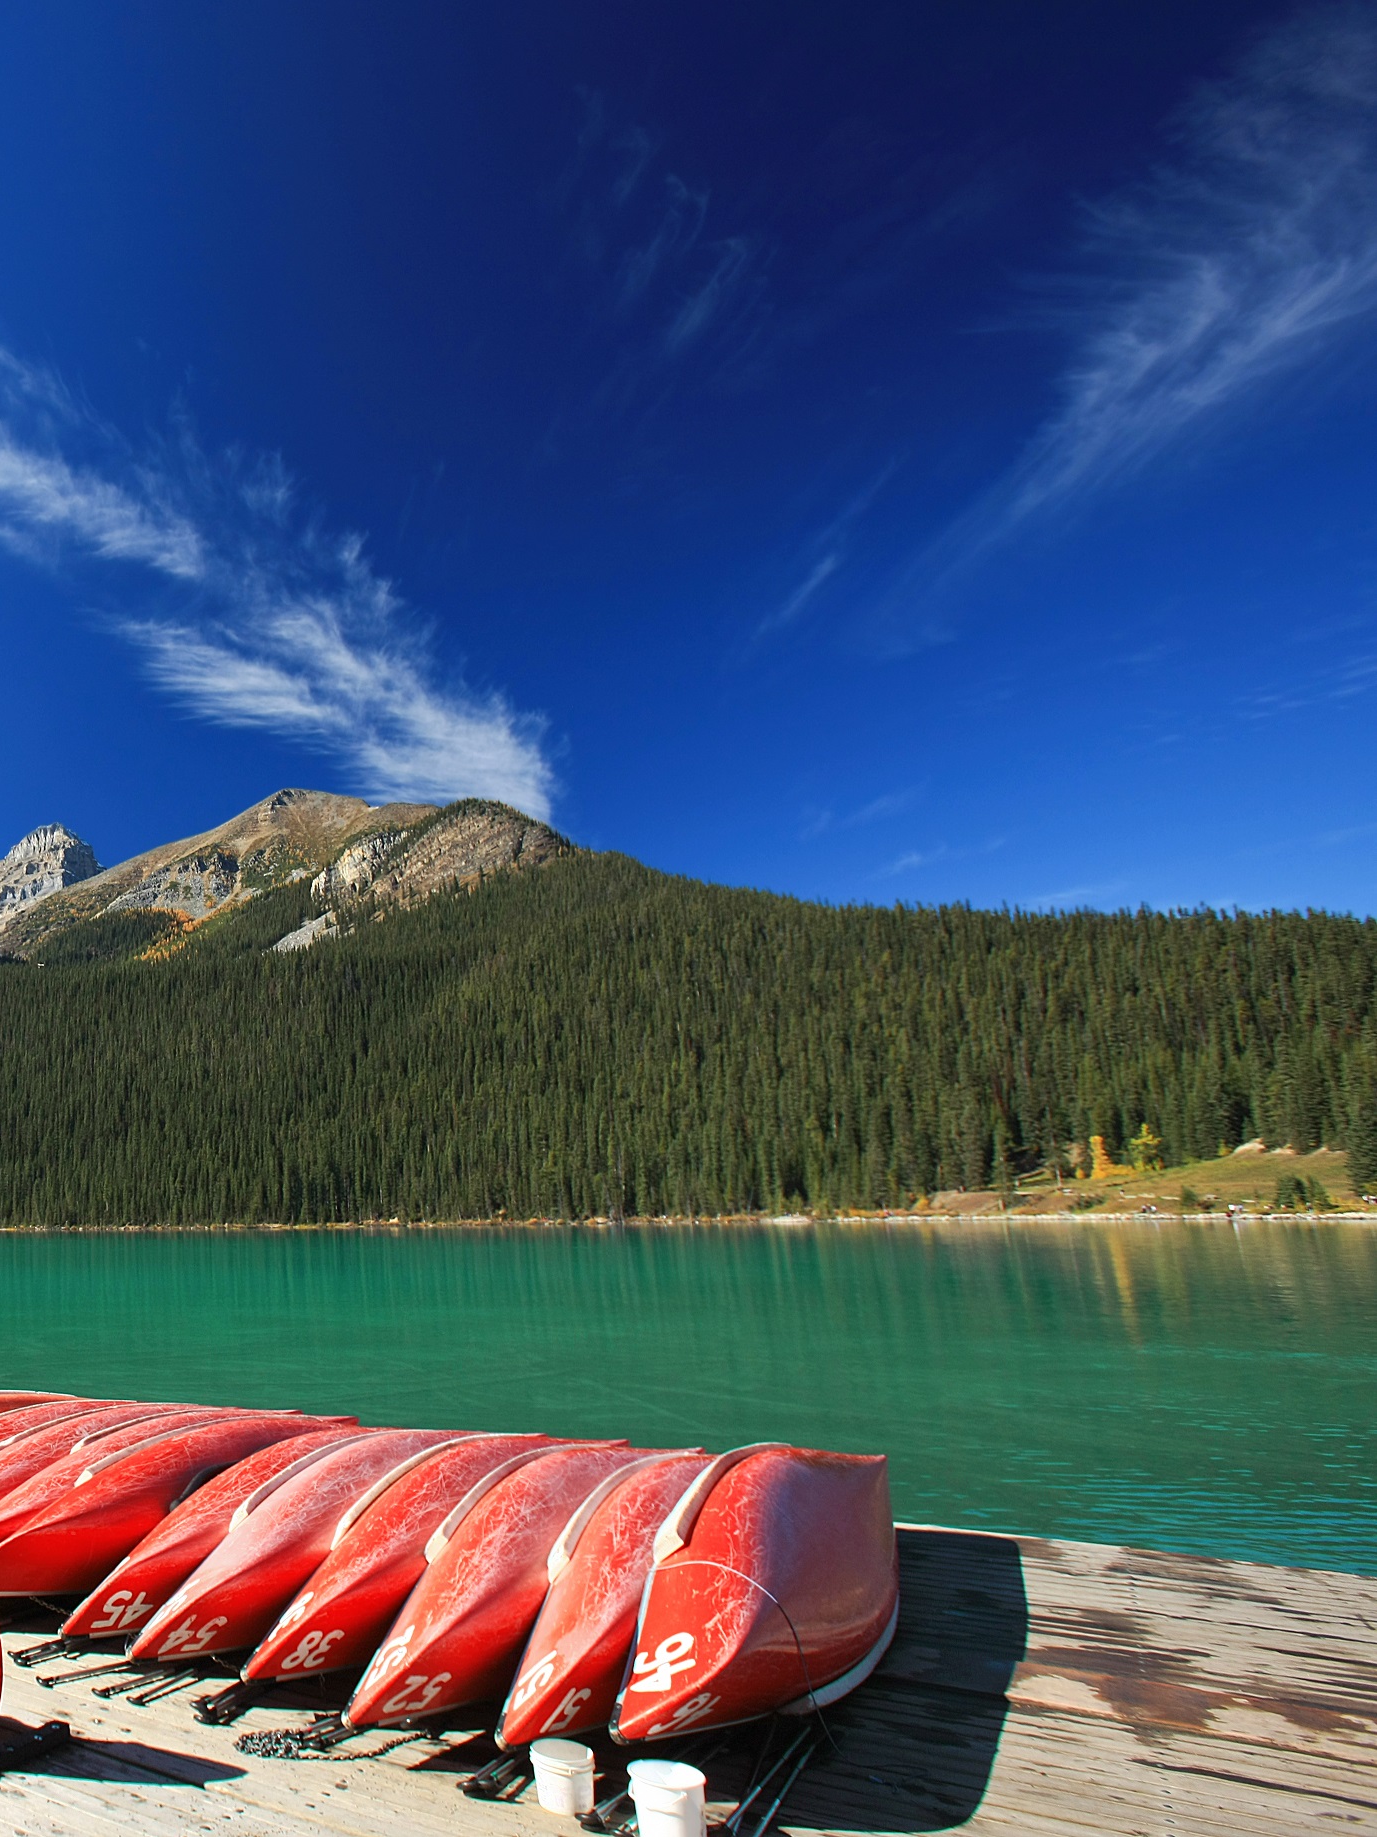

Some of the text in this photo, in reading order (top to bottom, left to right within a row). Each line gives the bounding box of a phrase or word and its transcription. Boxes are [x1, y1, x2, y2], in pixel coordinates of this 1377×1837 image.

[90, 1590, 154, 1629] 45
[157, 1614, 228, 1655] 54
[281, 1629, 345, 1669] 38
[364, 1625, 415, 1691] 52
[630, 1632, 696, 1693] 46
[382, 1672, 452, 1714] 52
[513, 1650, 557, 1711] 51
[539, 1687, 592, 1734] 51
[646, 1692, 722, 1735] 46
